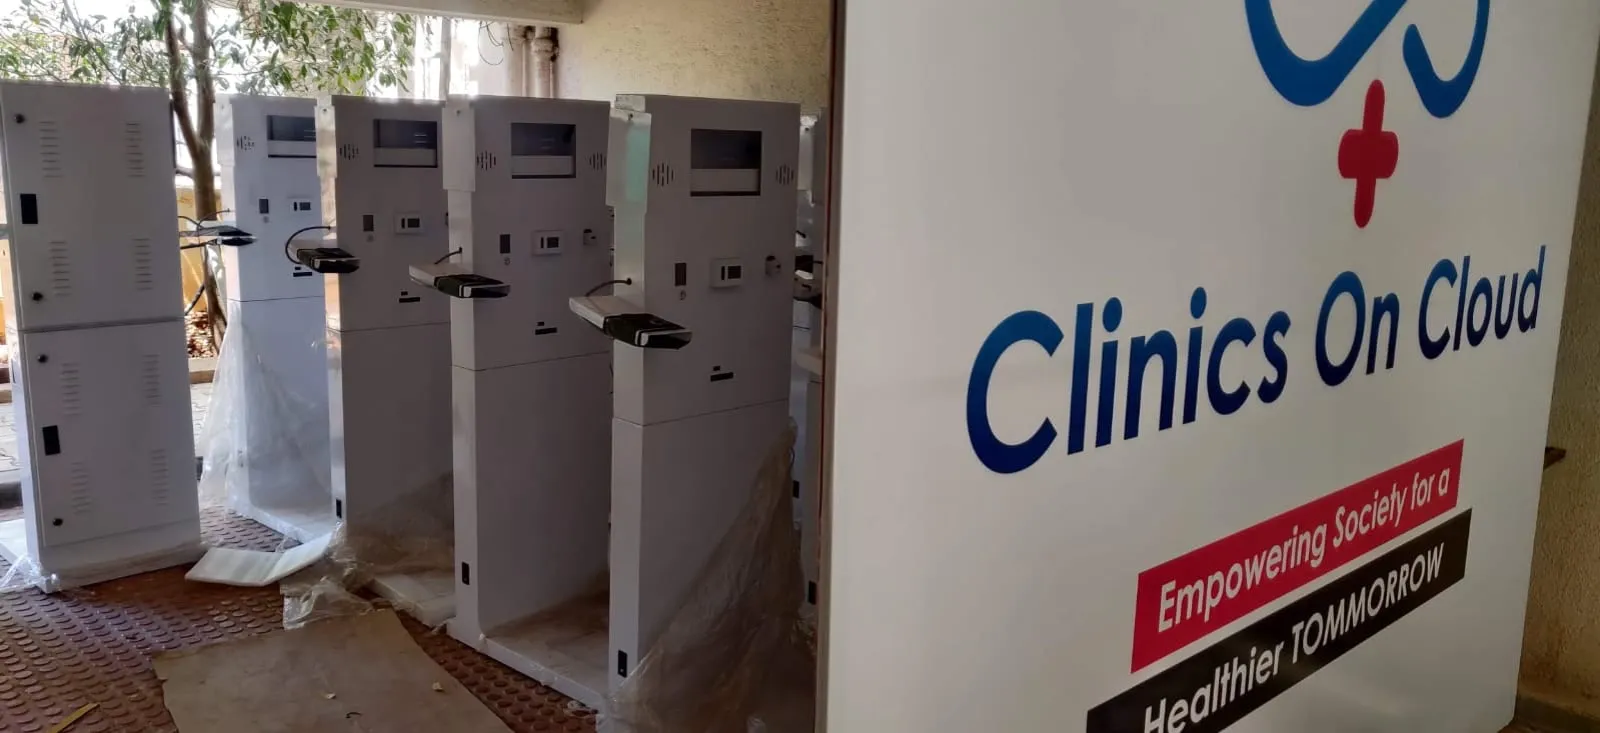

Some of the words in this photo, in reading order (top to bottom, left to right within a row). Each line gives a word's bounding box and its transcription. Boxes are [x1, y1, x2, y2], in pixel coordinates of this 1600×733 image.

[966, 286, 1291, 474] Clinics
[1315, 271, 1399, 387] On
[1418, 245, 1546, 361] Cloud
[1144, 641, 1284, 733] Healthier
[1291, 543, 1445, 664] TOMMORROW
[1157, 525, 1327, 633] Empowering
[1332, 484, 1407, 548] Society
[1411, 472, 1436, 510] for
[1438, 467, 1450, 497] a
